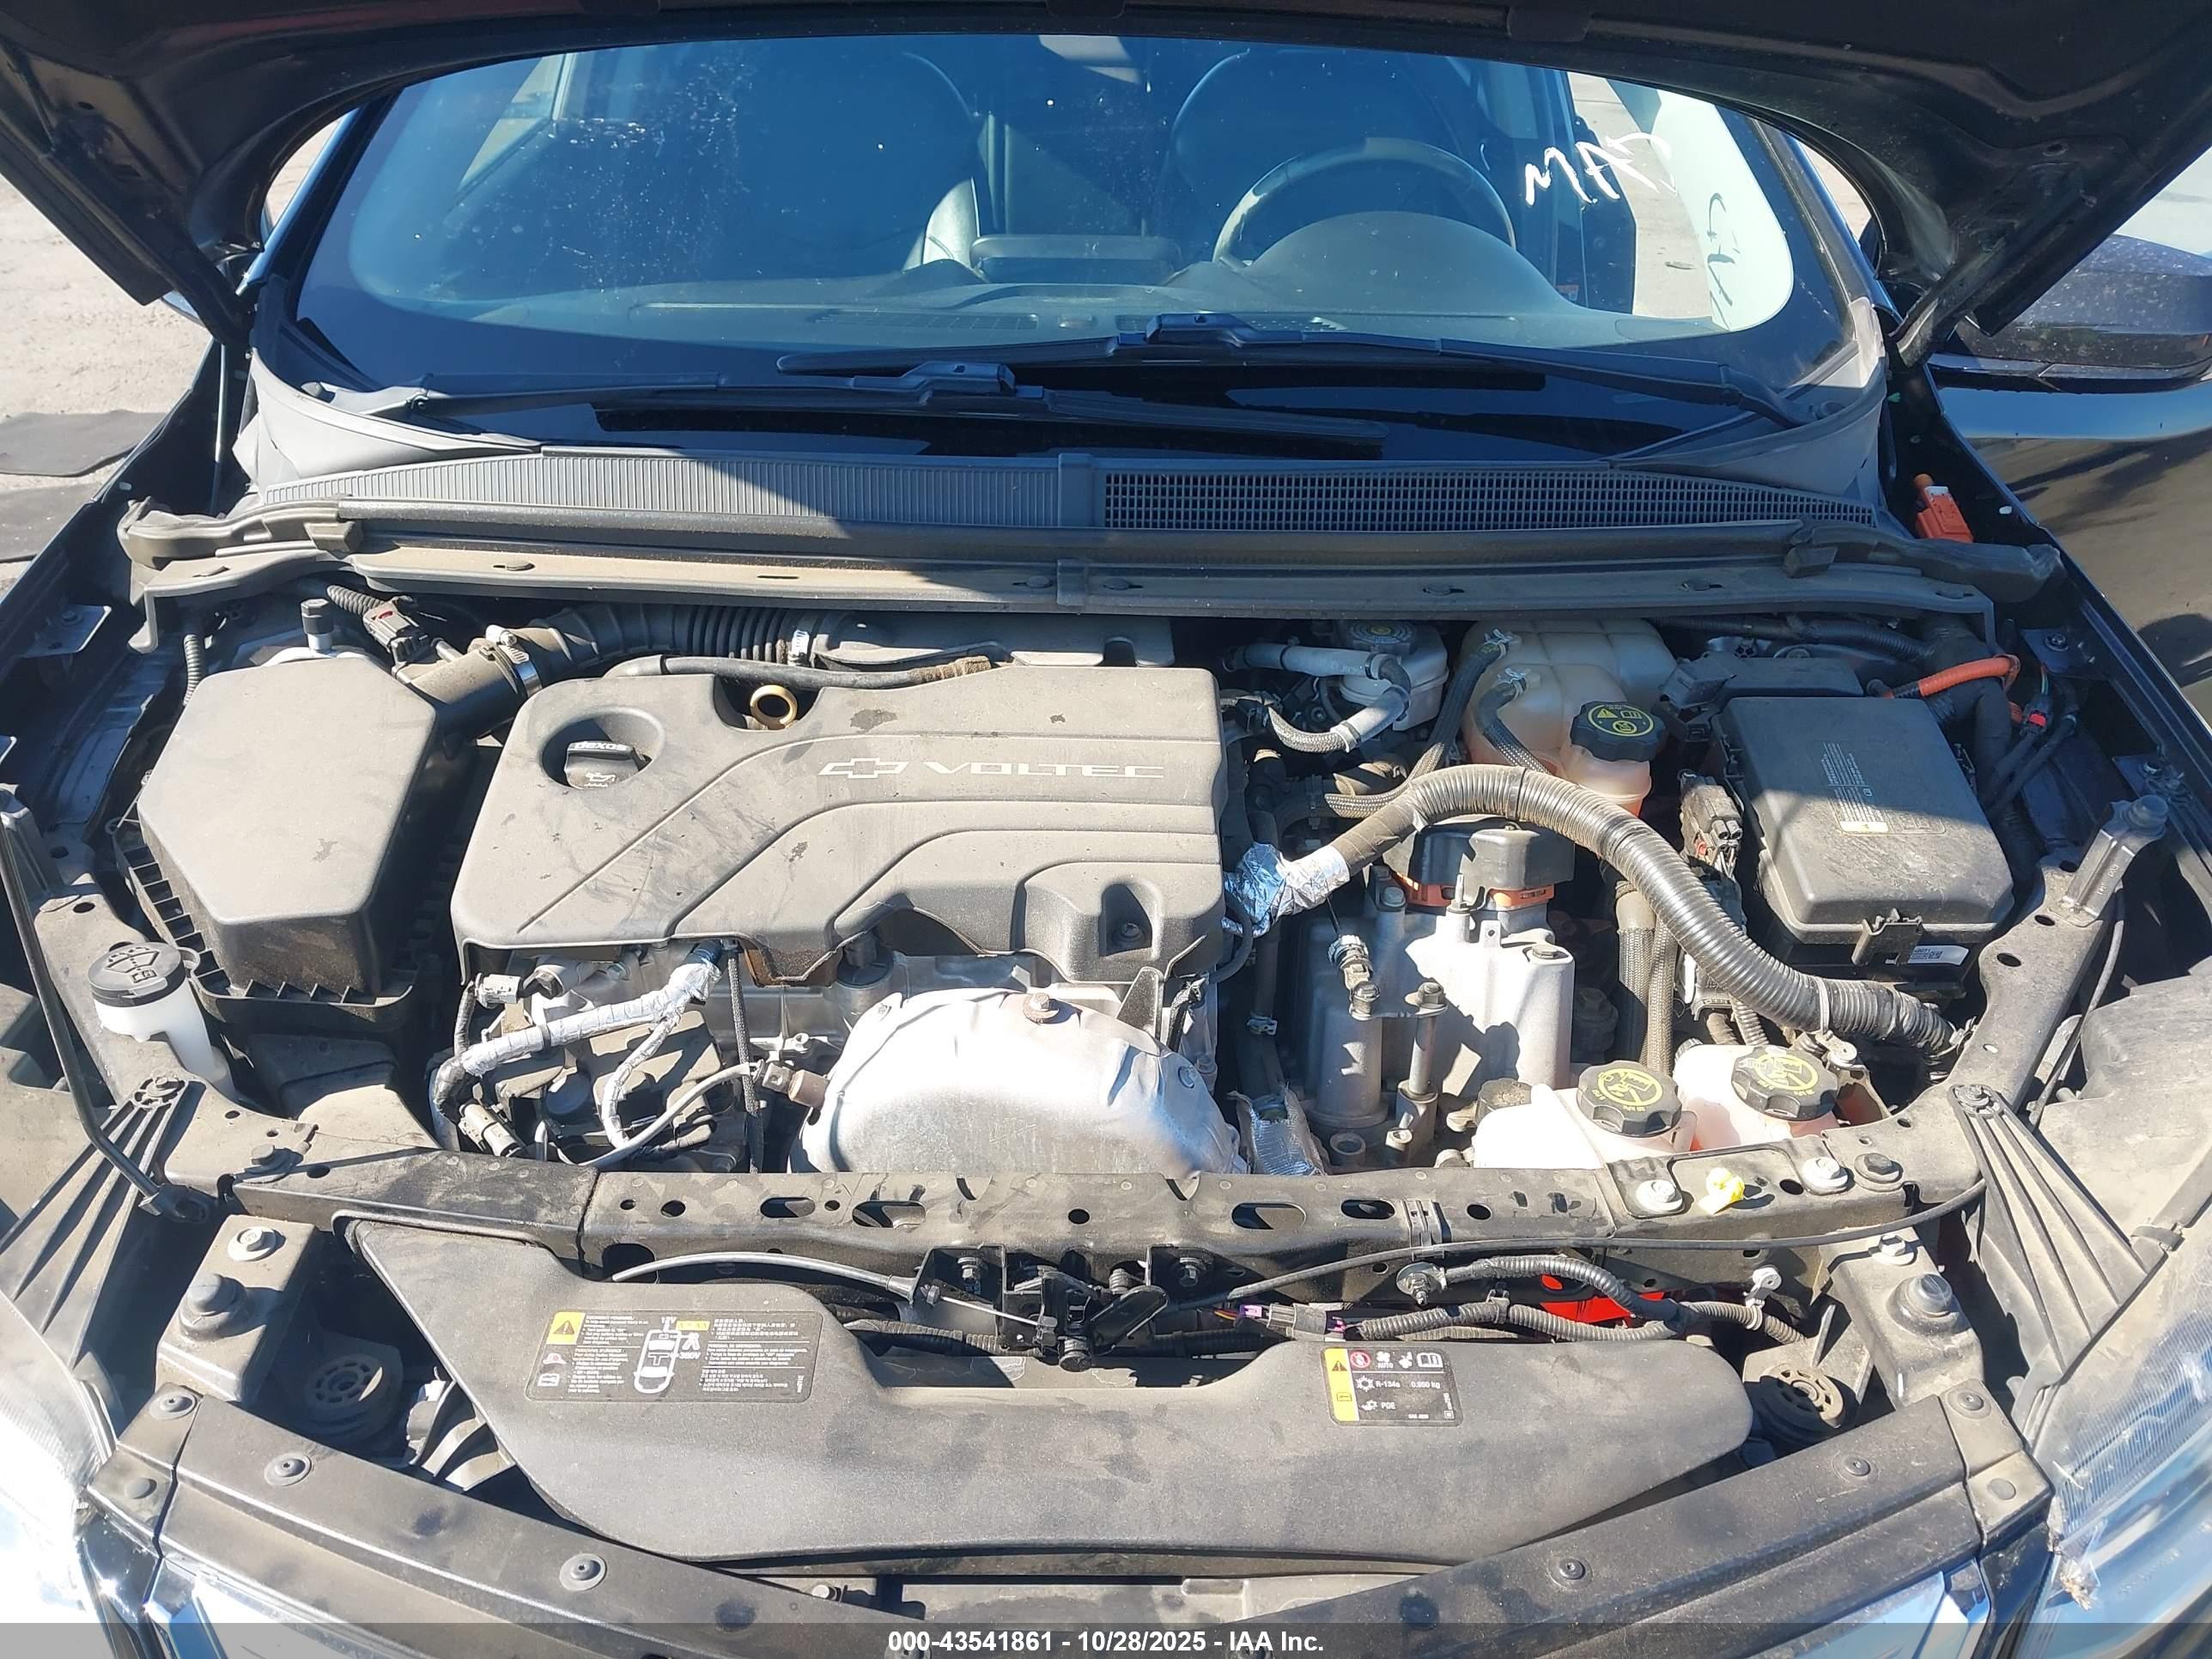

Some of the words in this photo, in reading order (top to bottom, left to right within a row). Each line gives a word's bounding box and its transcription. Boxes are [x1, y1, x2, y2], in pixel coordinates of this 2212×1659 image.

[574, 740, 628, 751] dexos
[923, 761, 1164, 779] VOLTEC
[1381, 1401, 1396, 1410] POE
